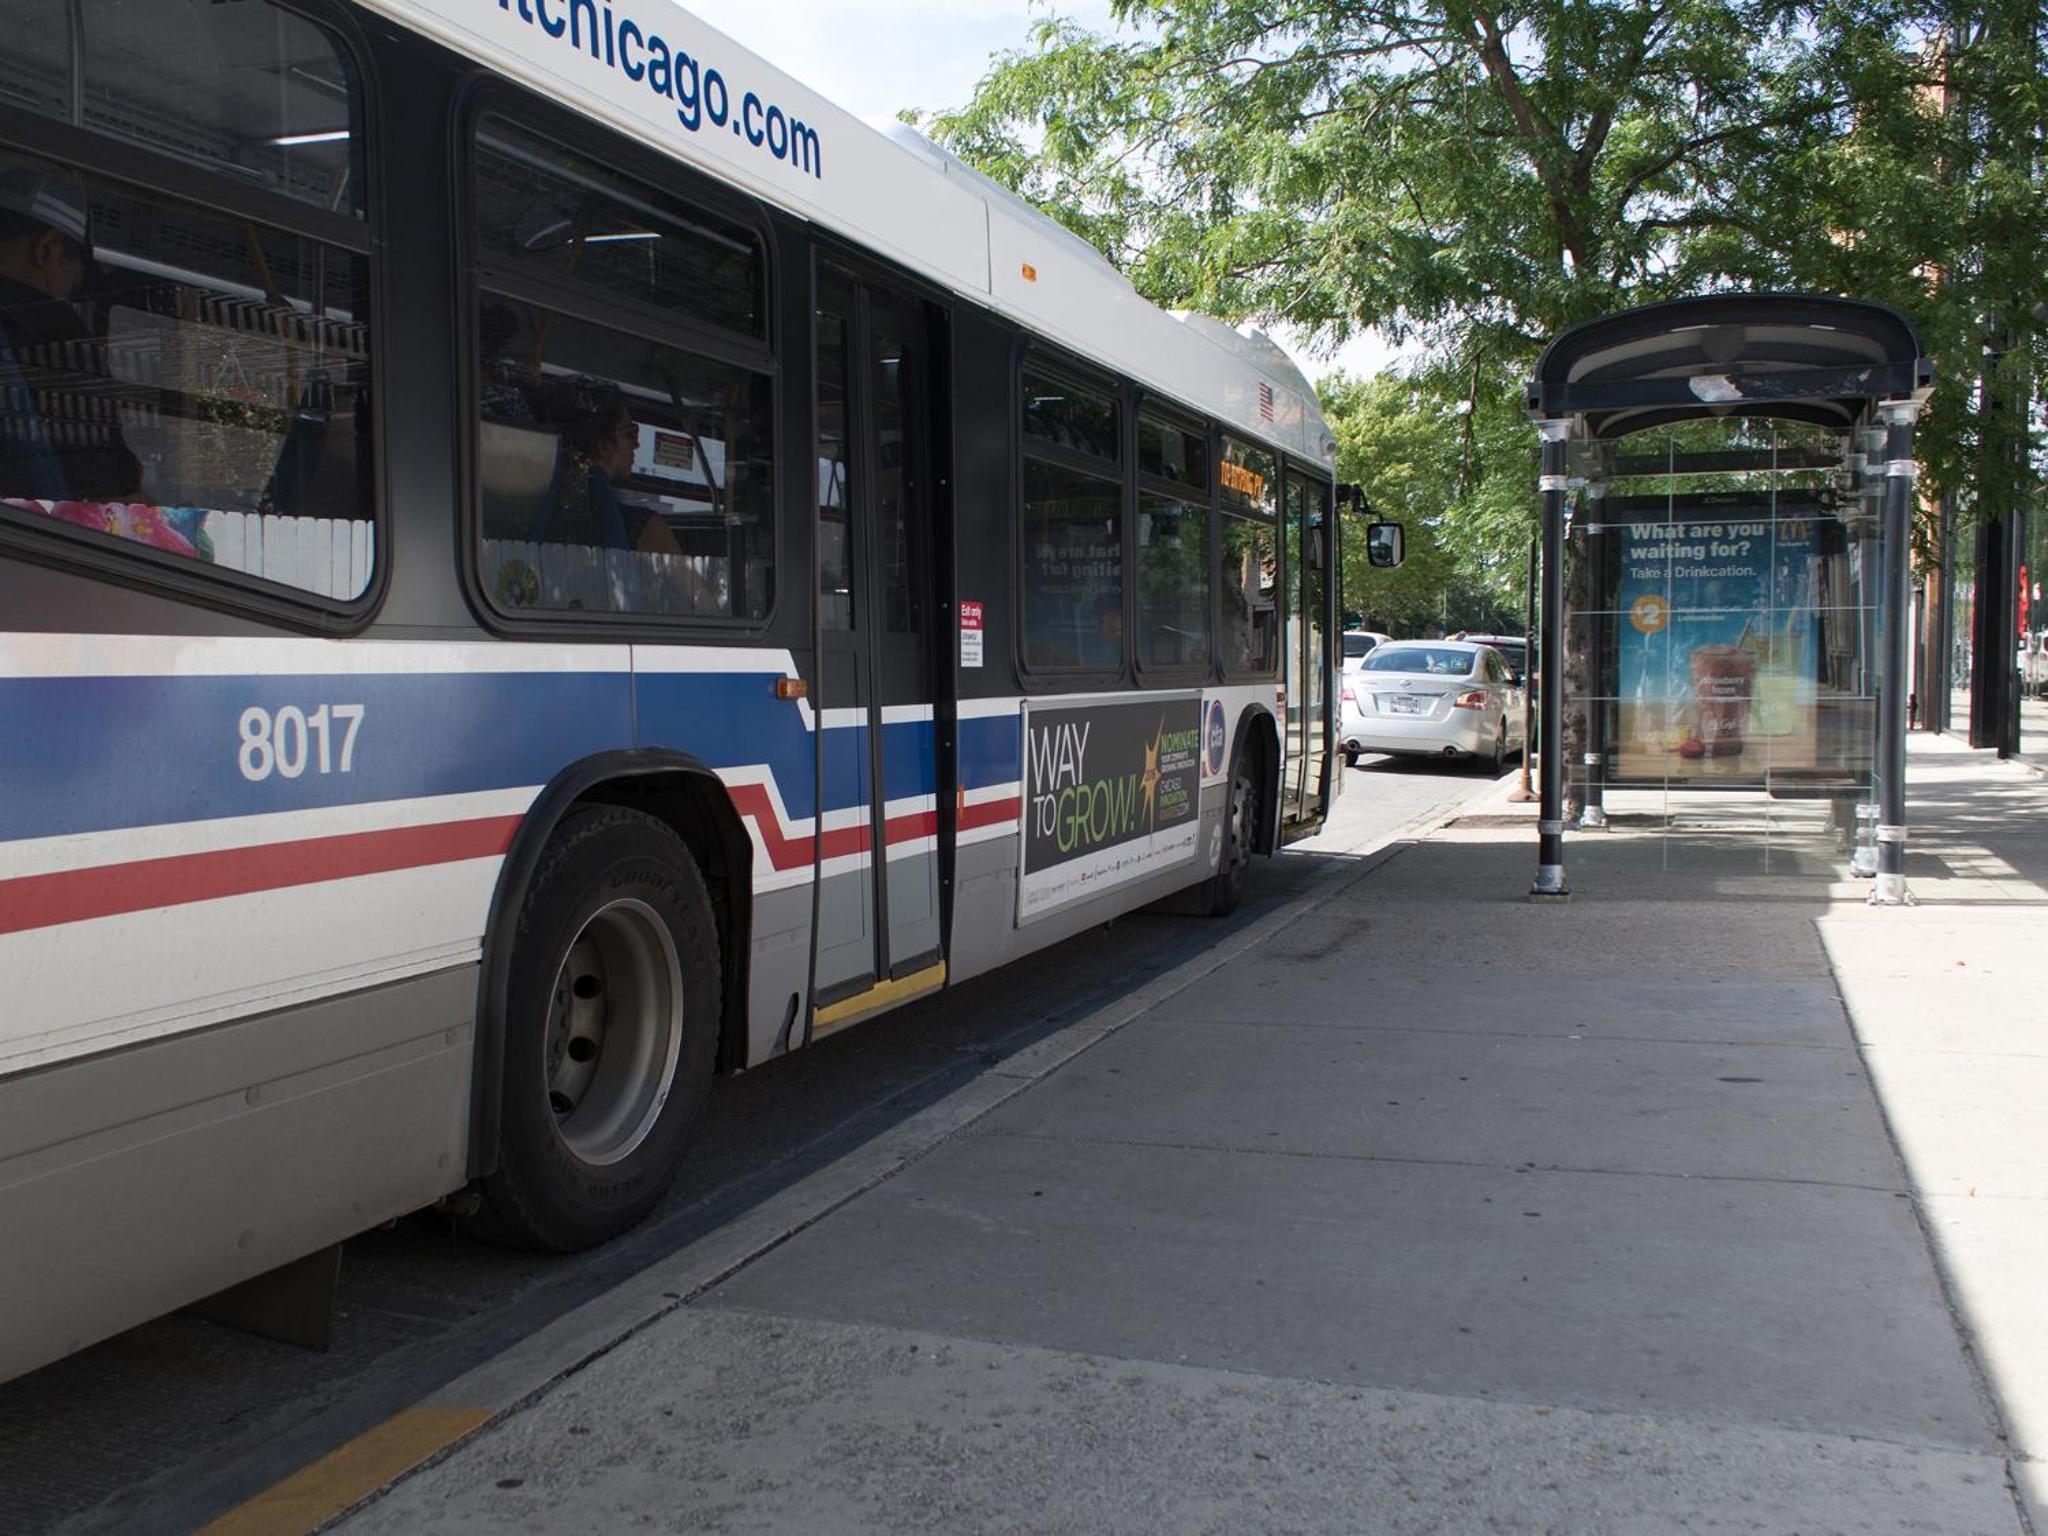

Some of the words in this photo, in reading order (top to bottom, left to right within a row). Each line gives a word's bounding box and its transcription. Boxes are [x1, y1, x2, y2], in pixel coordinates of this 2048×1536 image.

[498, 0, 822, 179] chicago.com
[1630, 542, 1706, 560] waiting
[1710, 541, 1751, 557] for?
[1631, 524, 1687, 540] What
[1690, 525, 1723, 538] are
[1727, 523, 1765, 540] you
[1630, 567, 1661, 579] Take
[1674, 564, 1757, 578] Drinkcation.
[239, 704, 364, 781] 8017
[1030, 721, 1090, 795] WAY
[1033, 793, 1057, 838] TO
[1056, 774, 1137, 853] GROW!
